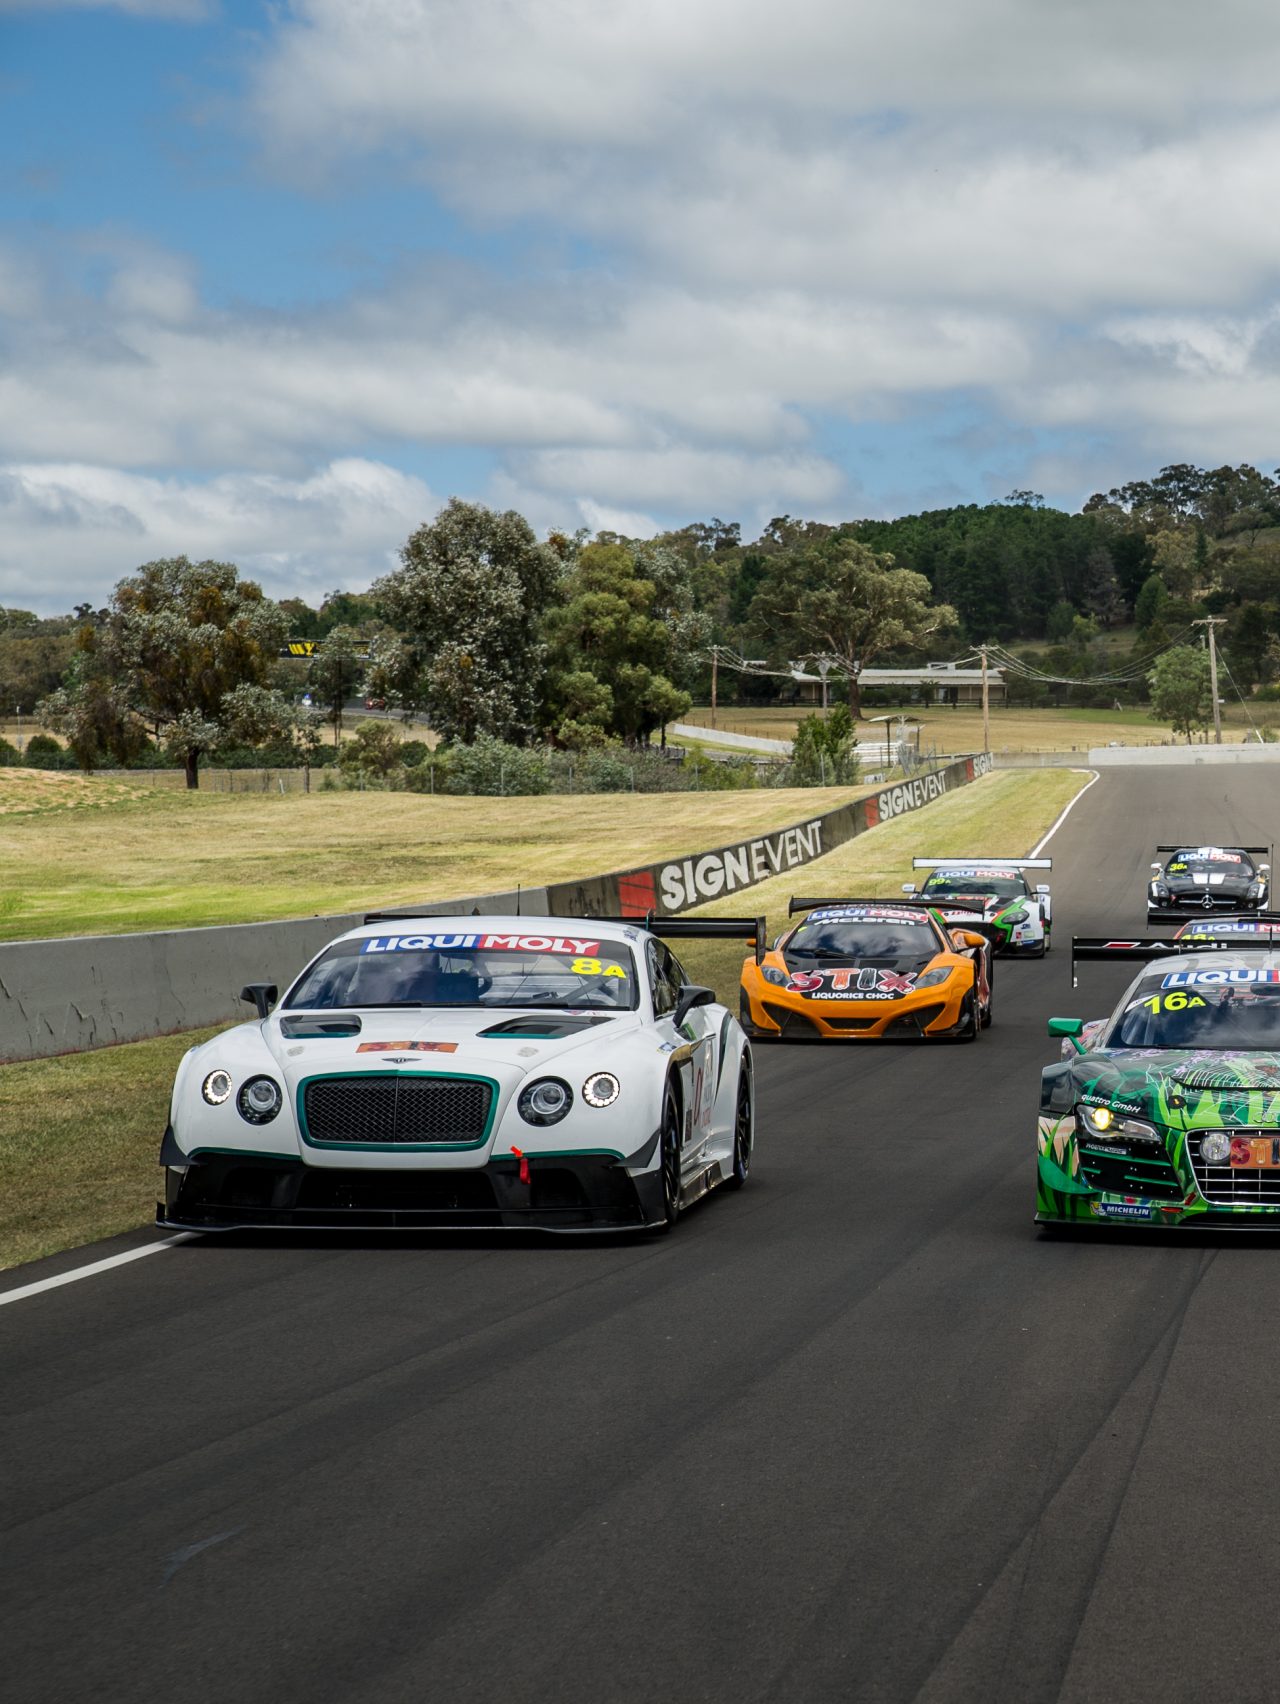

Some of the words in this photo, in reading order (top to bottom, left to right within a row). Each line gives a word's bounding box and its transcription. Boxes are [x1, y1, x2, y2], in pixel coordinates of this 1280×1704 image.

[977, 871, 1013, 879] MOLY
[811, 909, 866, 920] LIQUI
[870, 909, 927, 920] MOLY
[1197, 924, 1255, 933] LIQUI
[365, 935, 476, 953] LIQUI
[483, 935, 600, 955] MOLY
[785, 968, 918, 994] STIX
[1171, 970, 1268, 987] LIQUI
[1081, 1093, 1111, 1106] quattro
[1111, 1100, 1142, 1114] GmbH
[1106, 1205, 1150, 1216] MICHELIN
